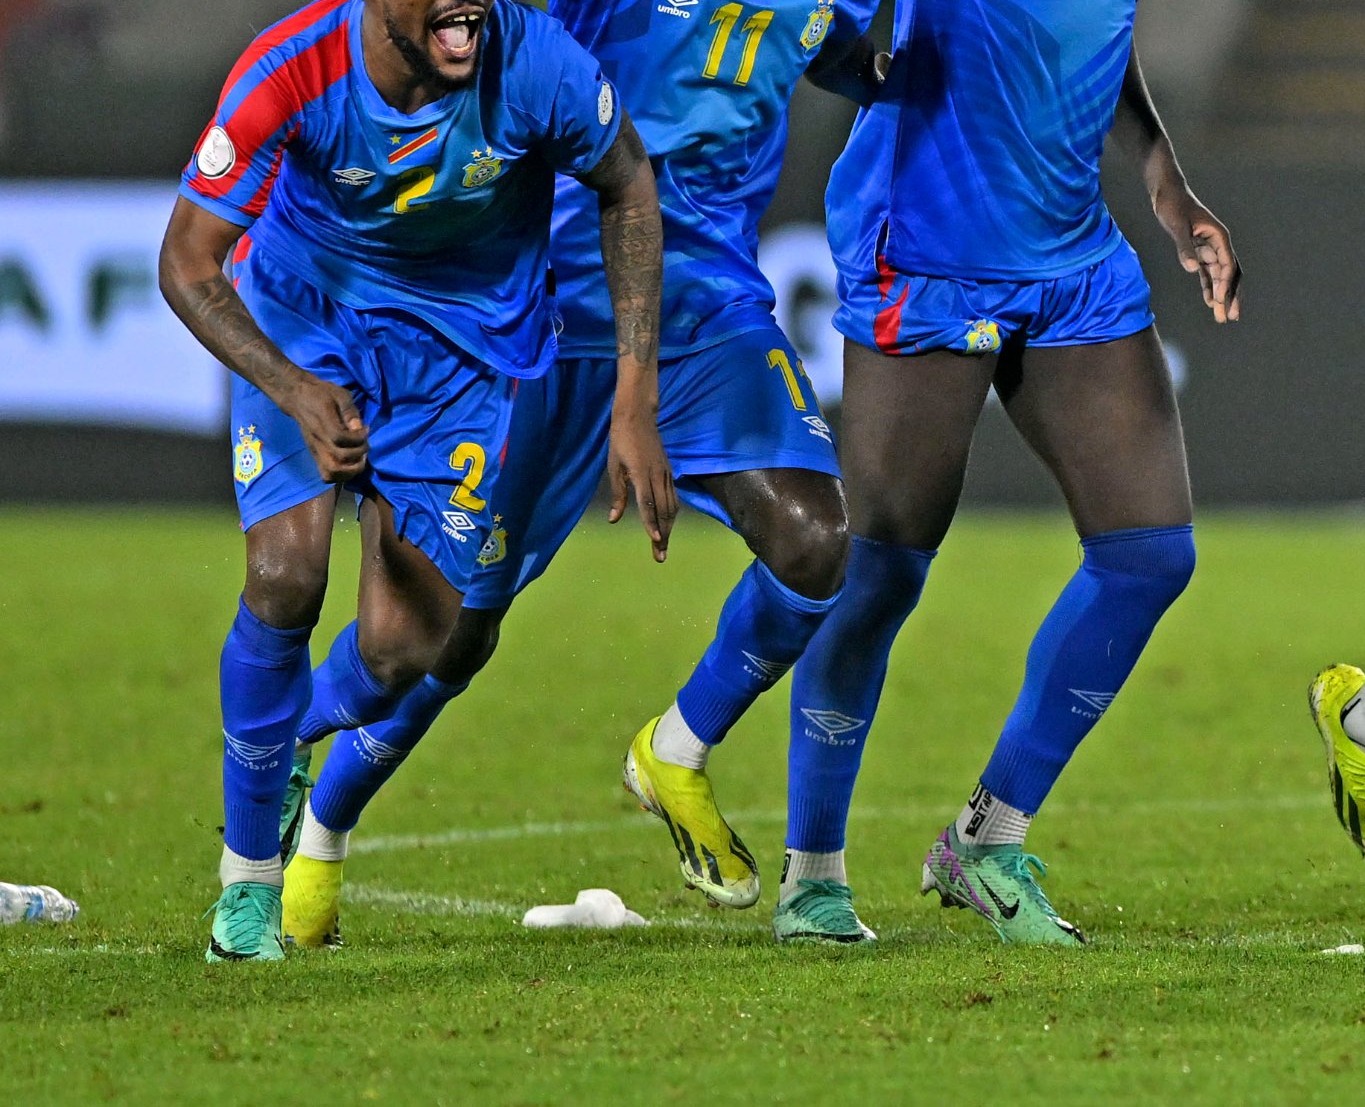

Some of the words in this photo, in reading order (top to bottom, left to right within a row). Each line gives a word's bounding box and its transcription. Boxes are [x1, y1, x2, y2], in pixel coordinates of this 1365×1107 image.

[657, 4, 691, 19] umbro
[702, 2, 775, 87] 11
[394, 166, 435, 214] 2
[450, 442, 487, 514] 2
[441, 522, 468, 543] umbro
[805, 727, 857, 747] umbro
